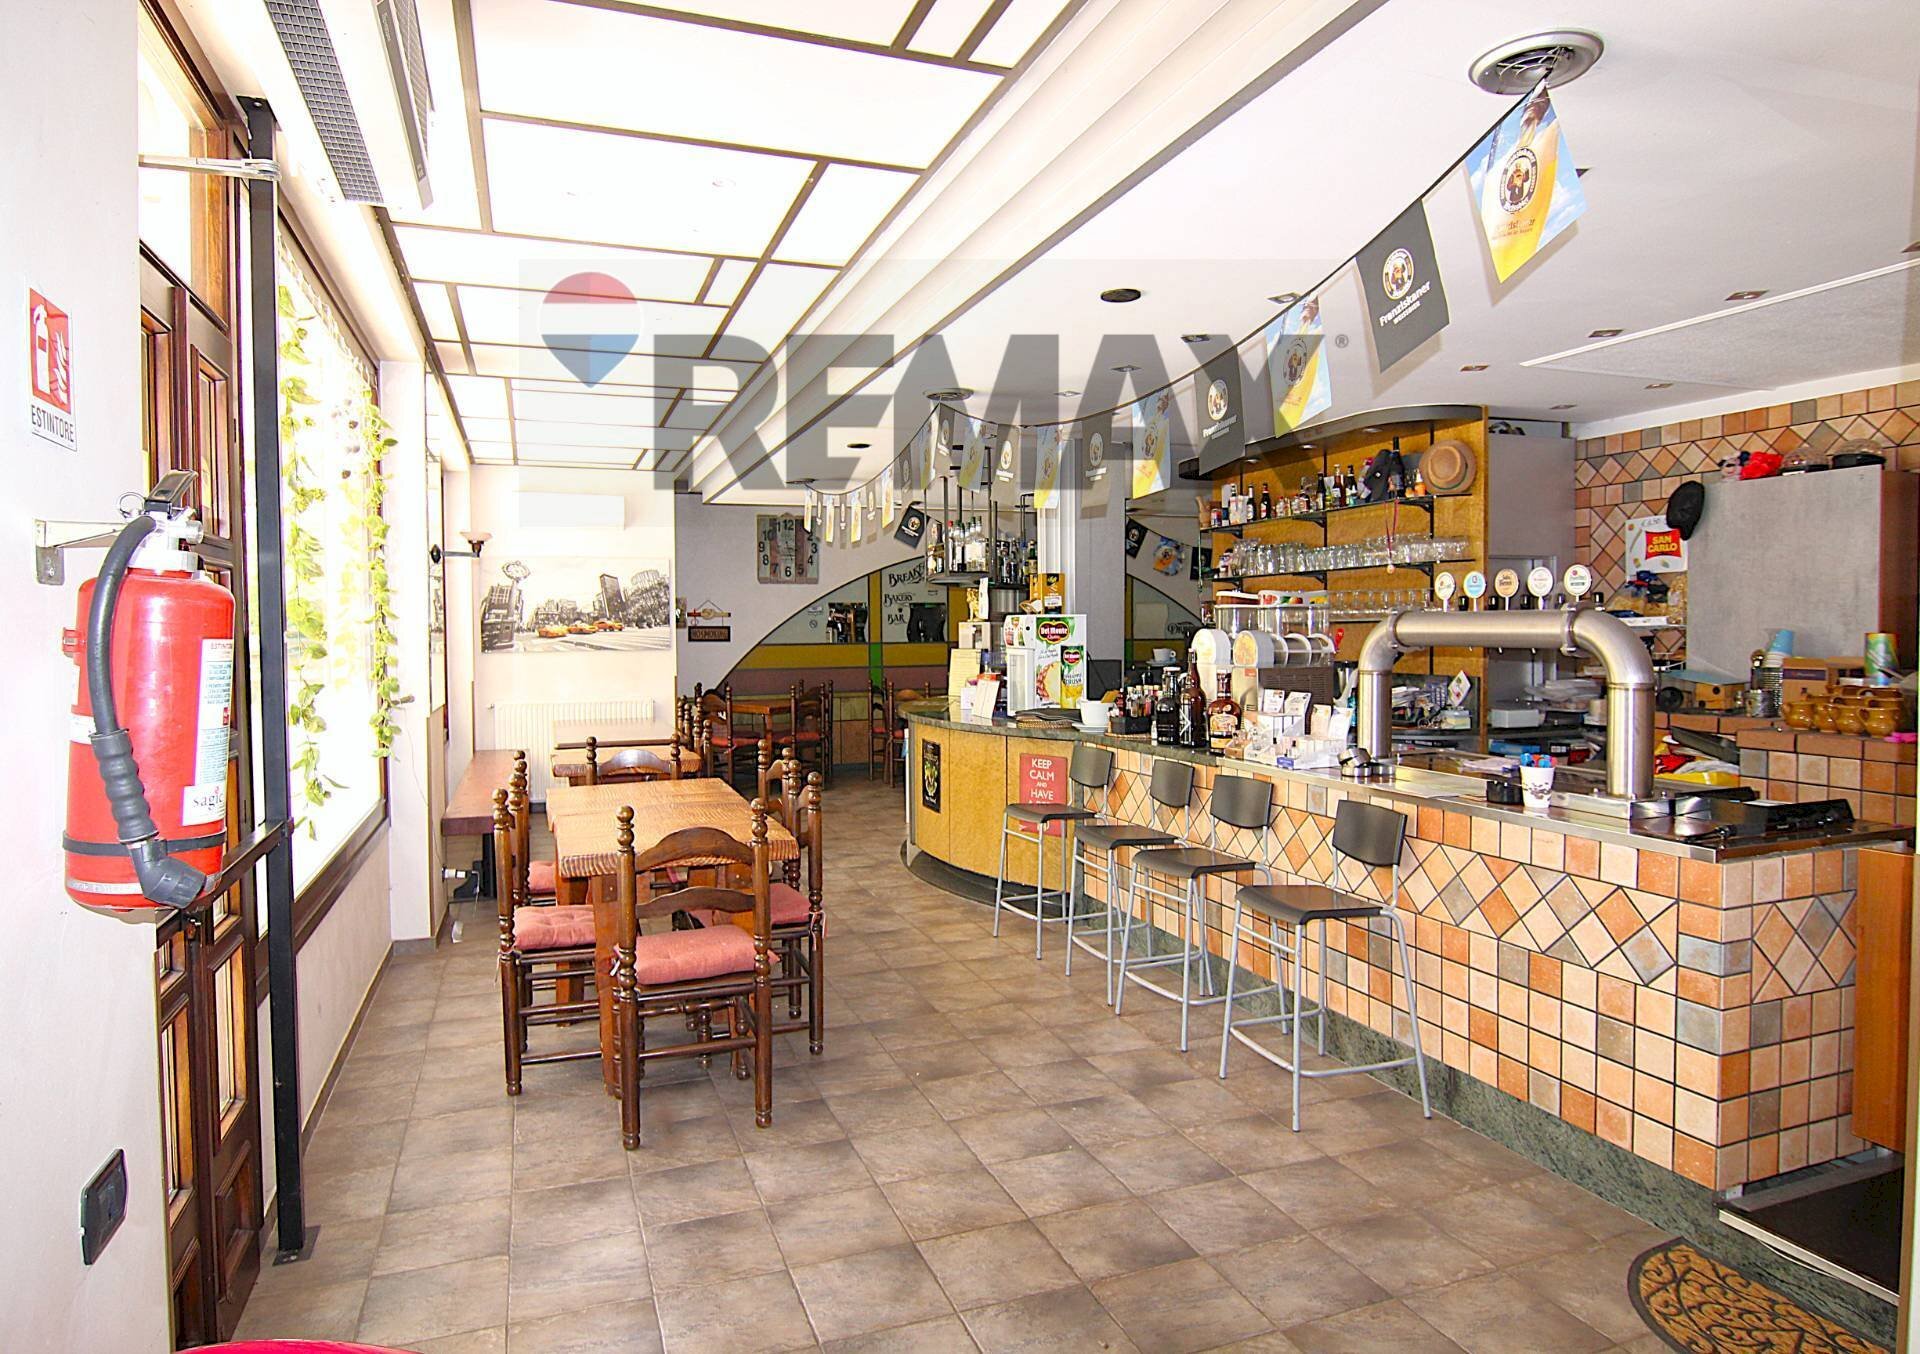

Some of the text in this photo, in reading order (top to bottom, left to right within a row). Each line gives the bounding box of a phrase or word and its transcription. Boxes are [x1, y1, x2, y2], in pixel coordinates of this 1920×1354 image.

[31, 404, 74, 442] ESTINTORE
[783, 520, 794, 530] 12
[1652, 536, 1671, 544] SAN
[759, 542, 765, 552] 9
[811, 542, 818, 553] 3
[1648, 543, 1678, 553] CARLO
[762, 554, 813, 566] 8 4
[784, 566, 792, 577] 6
[887, 613, 907, 625] BAR
[1031, 758, 1053, 770] KEEP
[1029, 769, 1055, 781] CALM
[1030, 789, 1054, 801] HAVE
